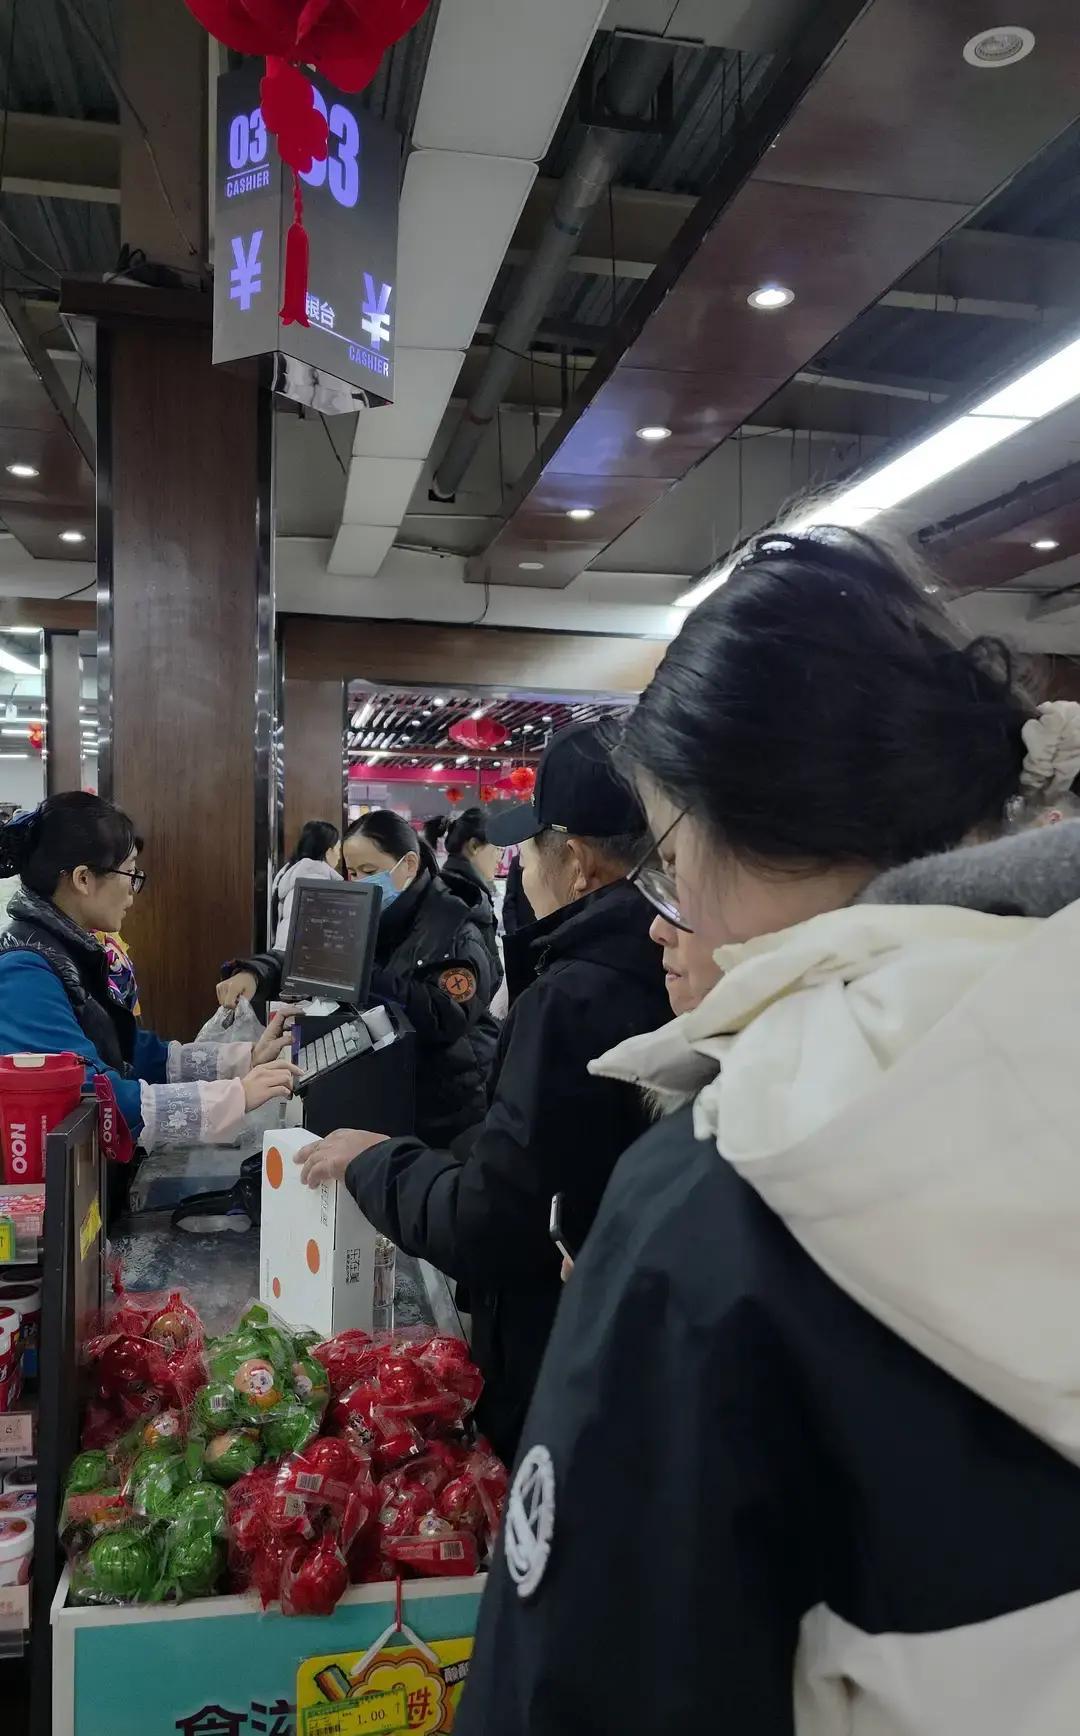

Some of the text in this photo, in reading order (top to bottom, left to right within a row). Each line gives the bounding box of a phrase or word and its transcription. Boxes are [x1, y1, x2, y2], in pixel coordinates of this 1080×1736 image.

[229, 107, 268, 170] 03
[226, 170, 270, 198] CASHIER
[348, 345, 389, 377] CASHIER
[357, 1709, 385, 1725] 1.00
